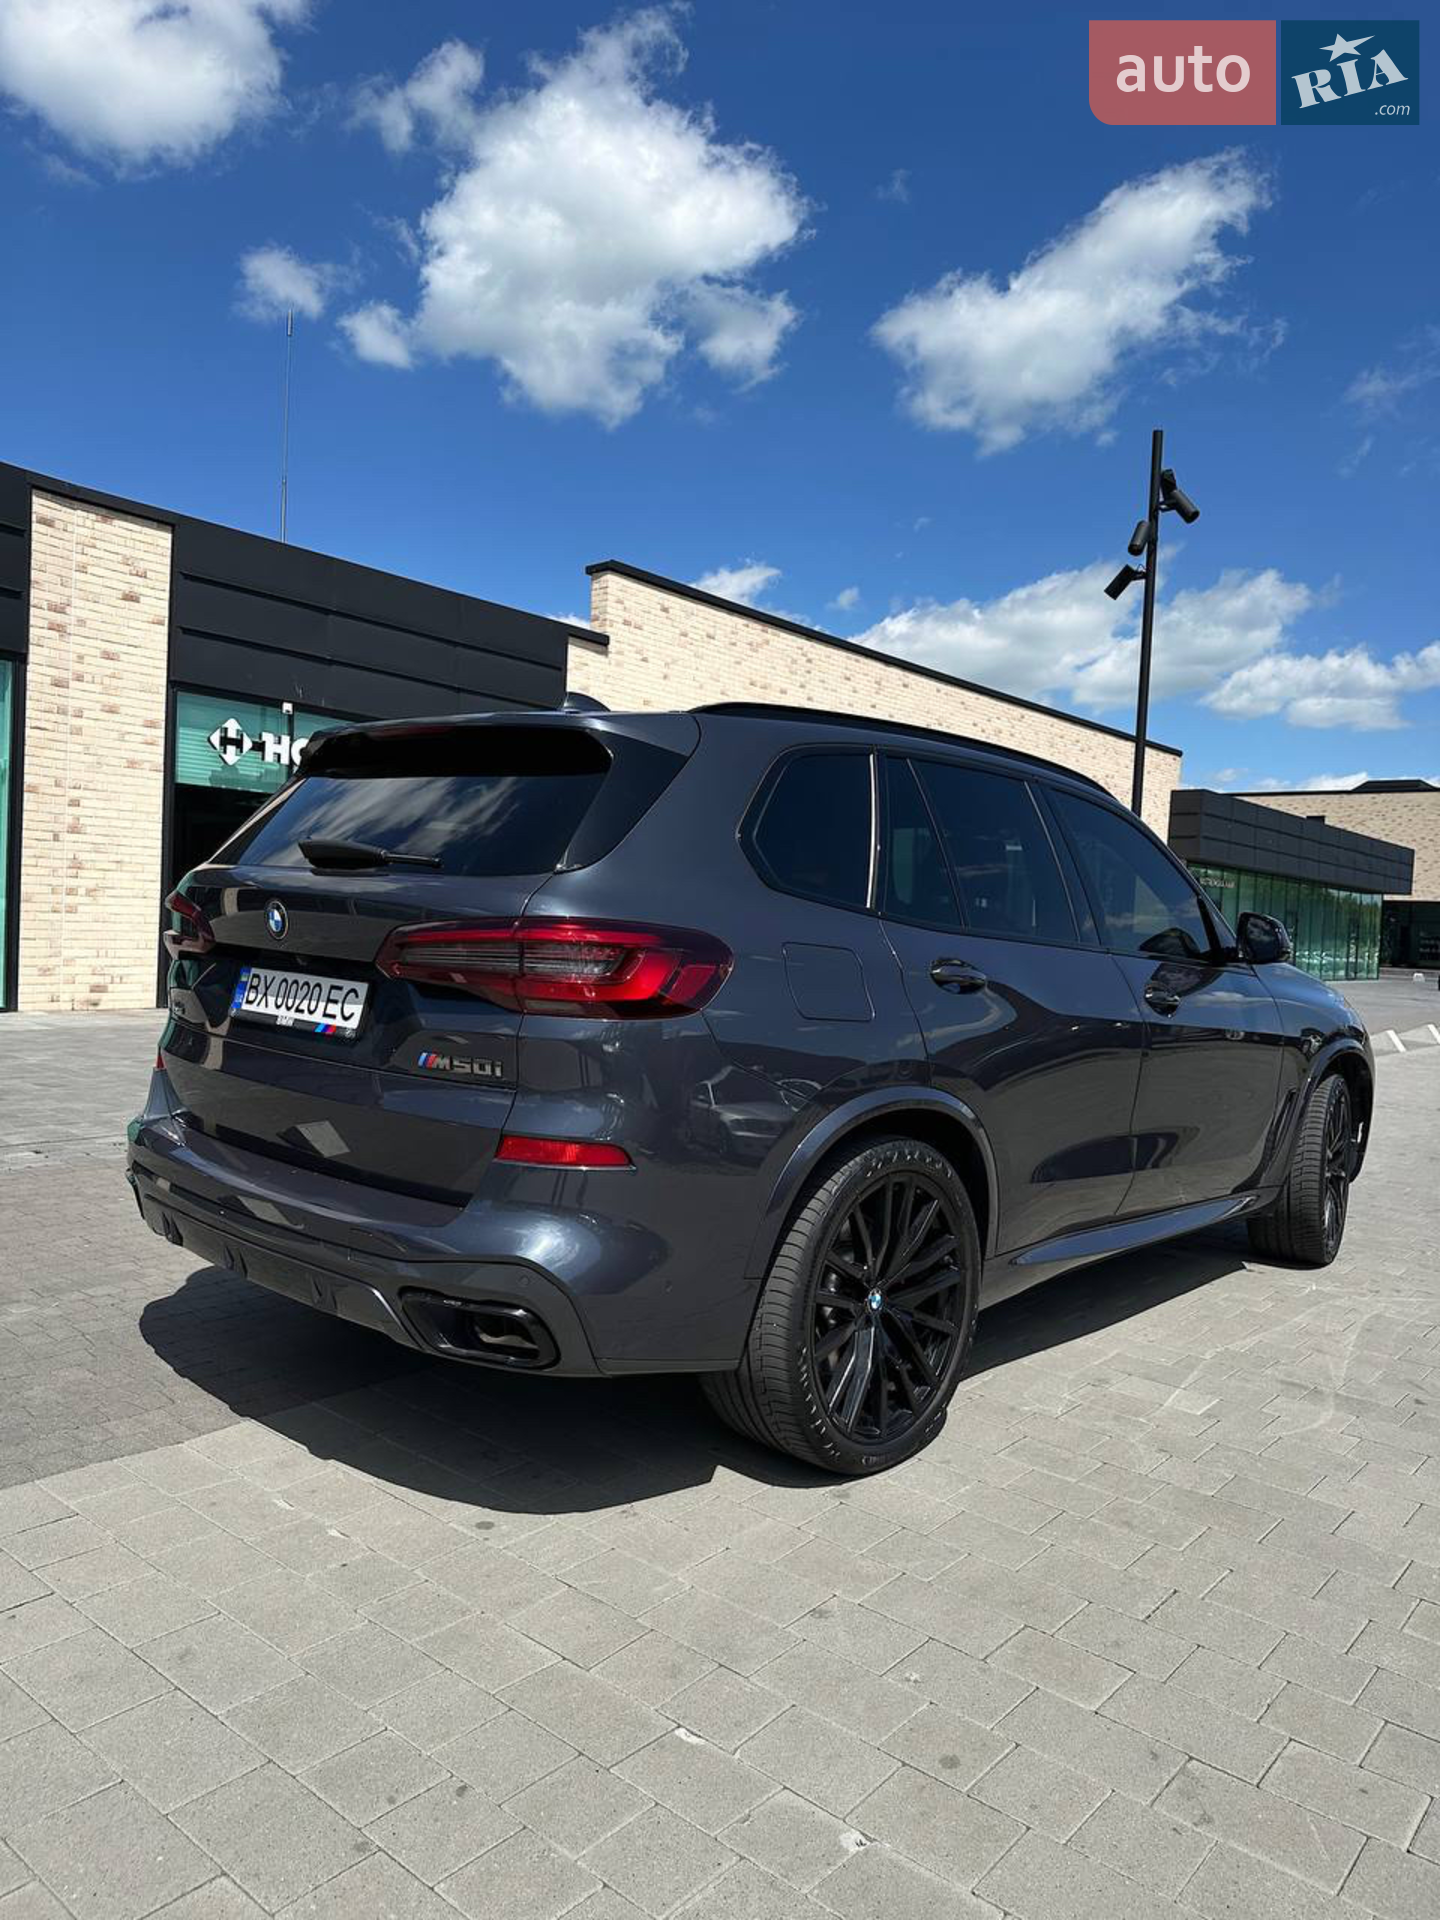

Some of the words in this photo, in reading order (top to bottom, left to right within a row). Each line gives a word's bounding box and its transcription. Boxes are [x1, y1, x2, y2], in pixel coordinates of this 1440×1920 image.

[246, 973, 276, 1008] BX
[274, 977, 323, 1015] 0020
[322, 985, 360, 1022] EC
